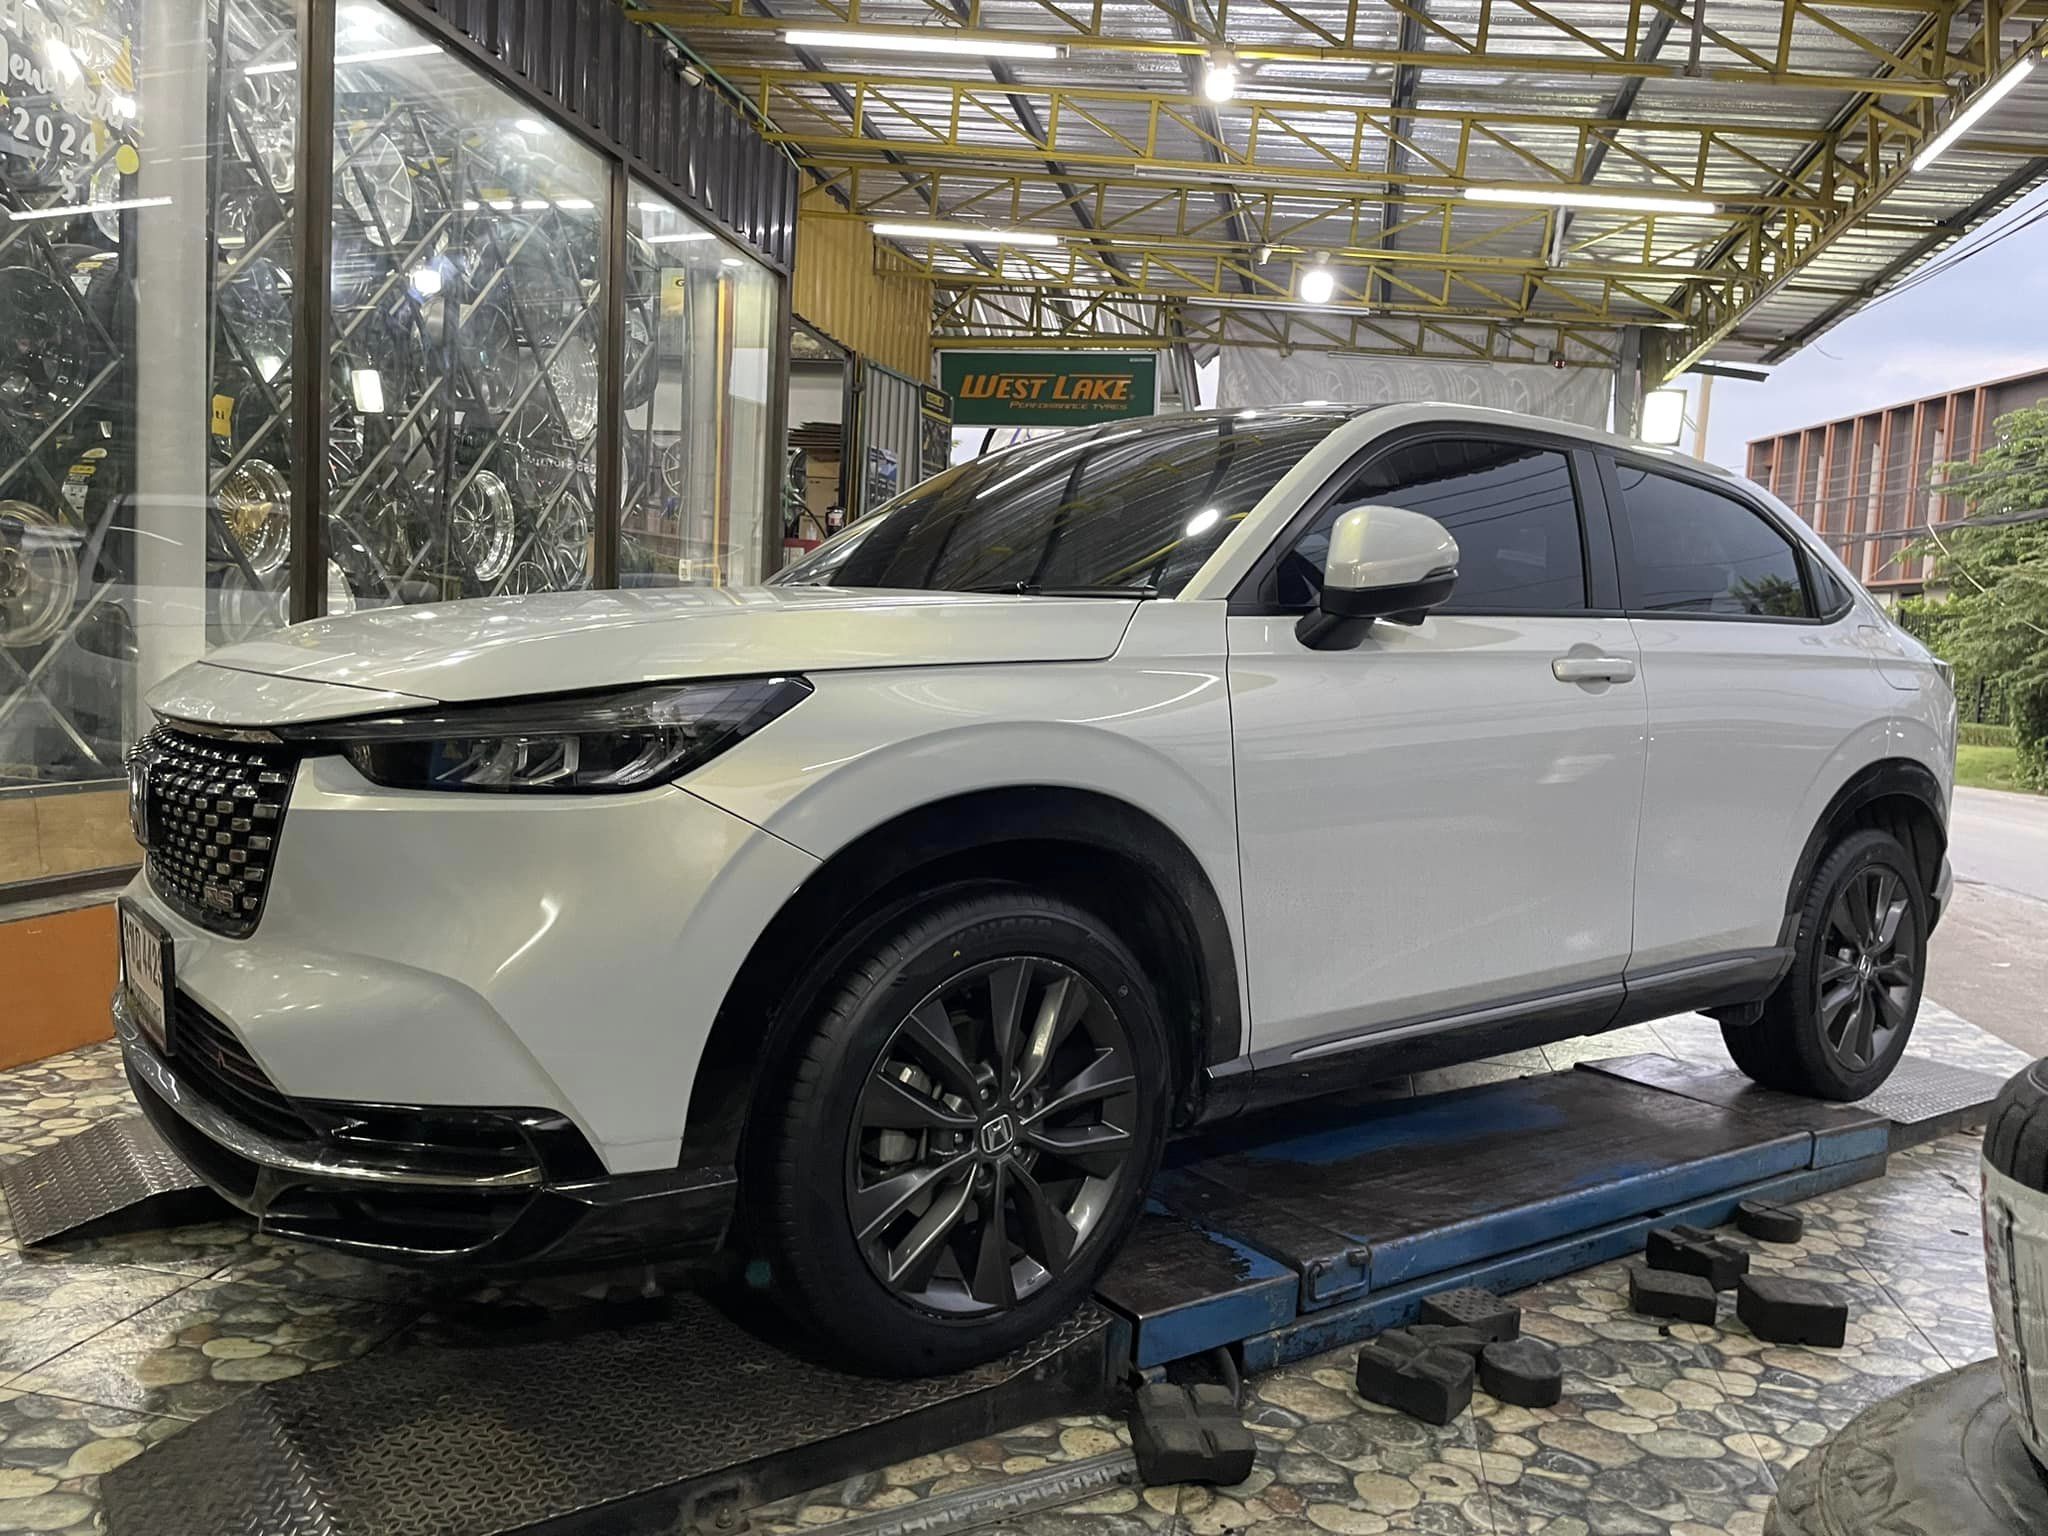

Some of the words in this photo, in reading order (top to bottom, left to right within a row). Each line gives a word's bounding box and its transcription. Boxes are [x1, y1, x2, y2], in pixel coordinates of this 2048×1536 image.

[13, 107, 98, 162] 2024
[959, 374, 1047, 400] WEST
[1052, 375, 1132, 400] LAKE
